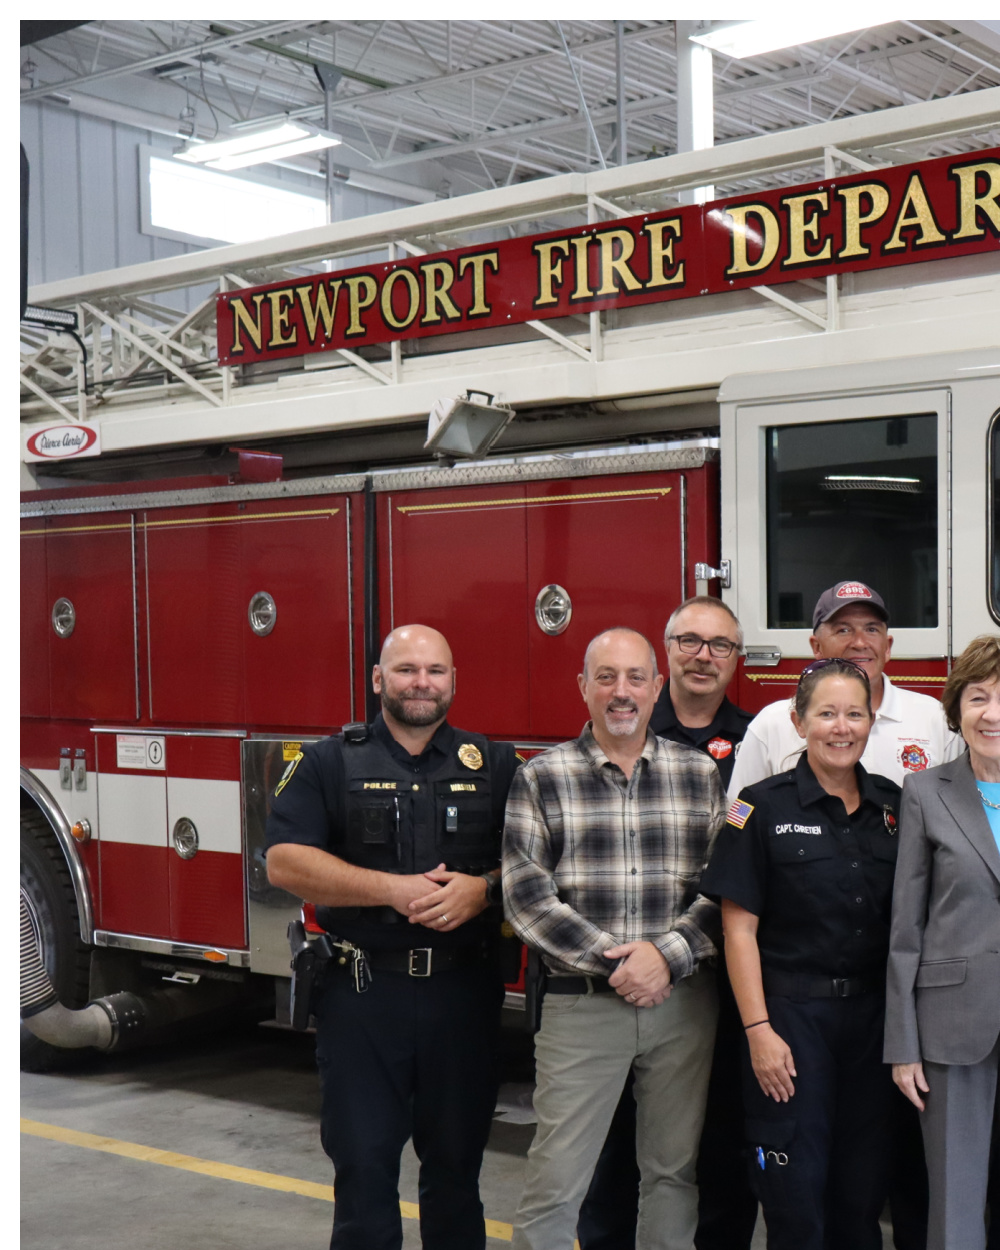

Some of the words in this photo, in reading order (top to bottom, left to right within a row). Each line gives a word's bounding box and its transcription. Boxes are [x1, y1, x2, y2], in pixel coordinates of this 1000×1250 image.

[229, 250, 499, 353] NEWPORT
[533, 216, 687, 307] FIRE
[845, 586, 864, 594] 695
[363, 782, 397, 790] POLICE
[775, 824, 793, 835] CAPT.
[793, 824, 822, 835] CHRETIEN
